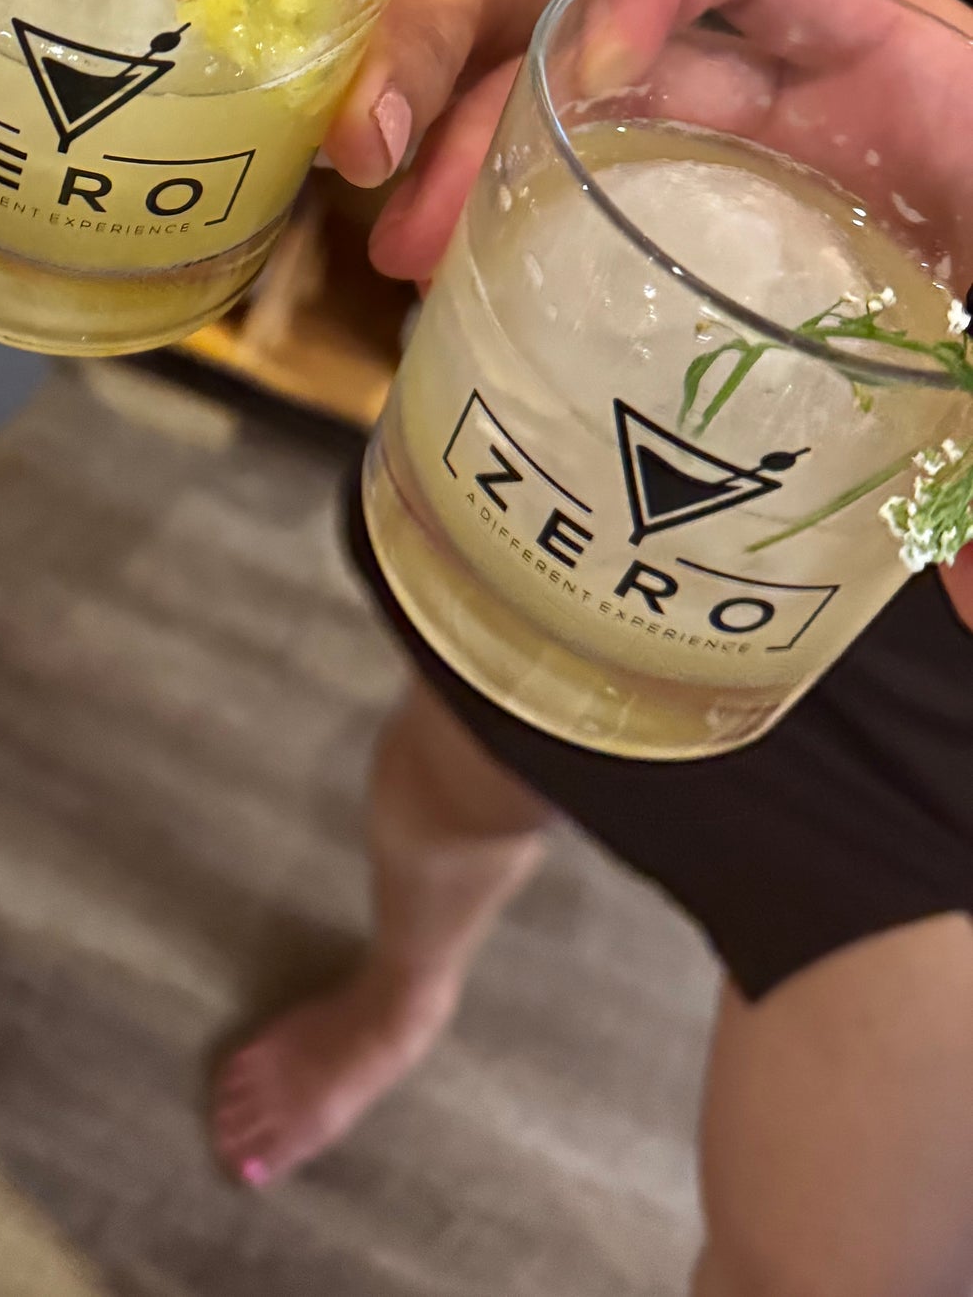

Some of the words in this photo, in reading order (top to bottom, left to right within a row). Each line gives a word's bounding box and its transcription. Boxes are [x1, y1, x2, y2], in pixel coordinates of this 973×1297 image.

[49, 212, 190, 235] EXPERIENCE
[466, 492, 476, 505] A
[479, 506, 592, 602] DIFFERENT
[599, 601, 753, 653] EXPERIENCE
[475, 443, 776, 634] ZERO
